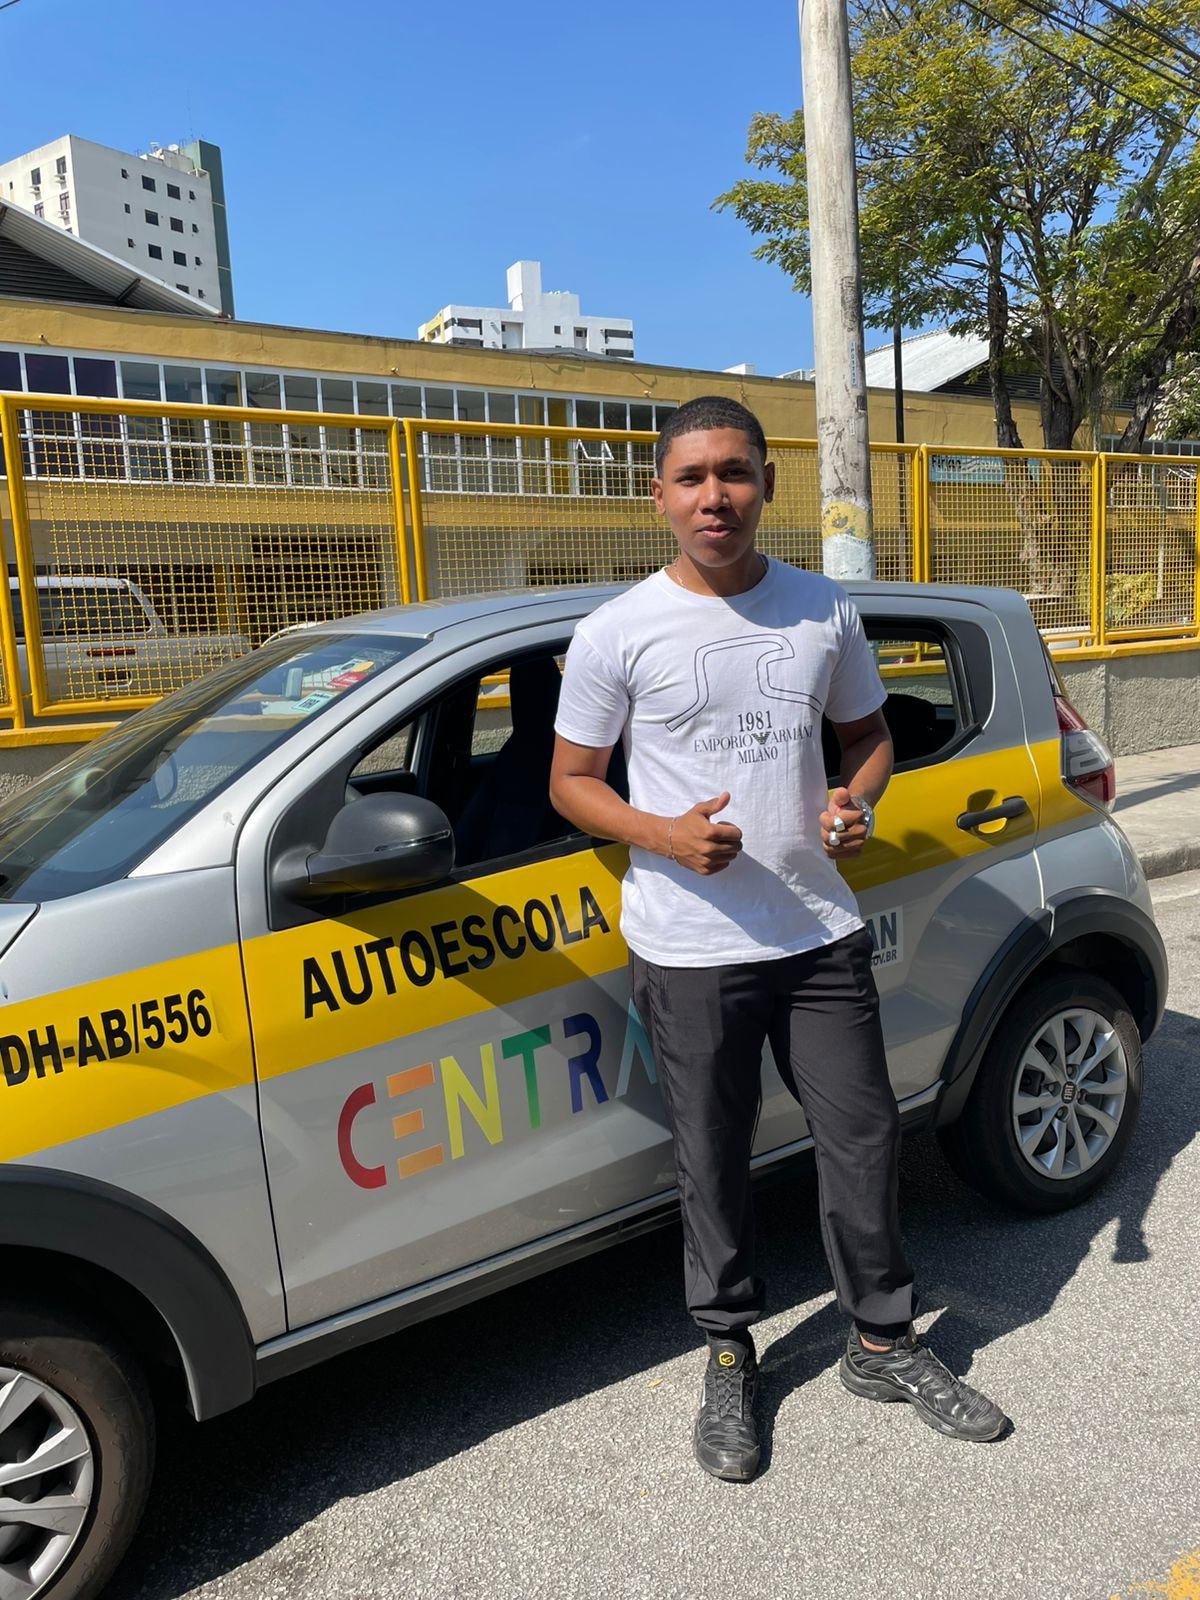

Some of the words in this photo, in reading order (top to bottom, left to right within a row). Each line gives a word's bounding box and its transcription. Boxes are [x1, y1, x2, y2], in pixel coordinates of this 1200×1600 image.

[738, 710, 773, 732] 1981
[694, 733, 753, 753] EMPORIO
[769, 725, 814, 744] ARMANI
[737, 746, 778, 765] MILANO
[866, 911, 897, 951] AN
[303, 886, 610, 1019] AUTOESCOLA
[871, 949, 897, 966] OV.BR
[0, 988, 212, 1087] DH-AB/556
[337, 996, 657, 1190] CENTRA
